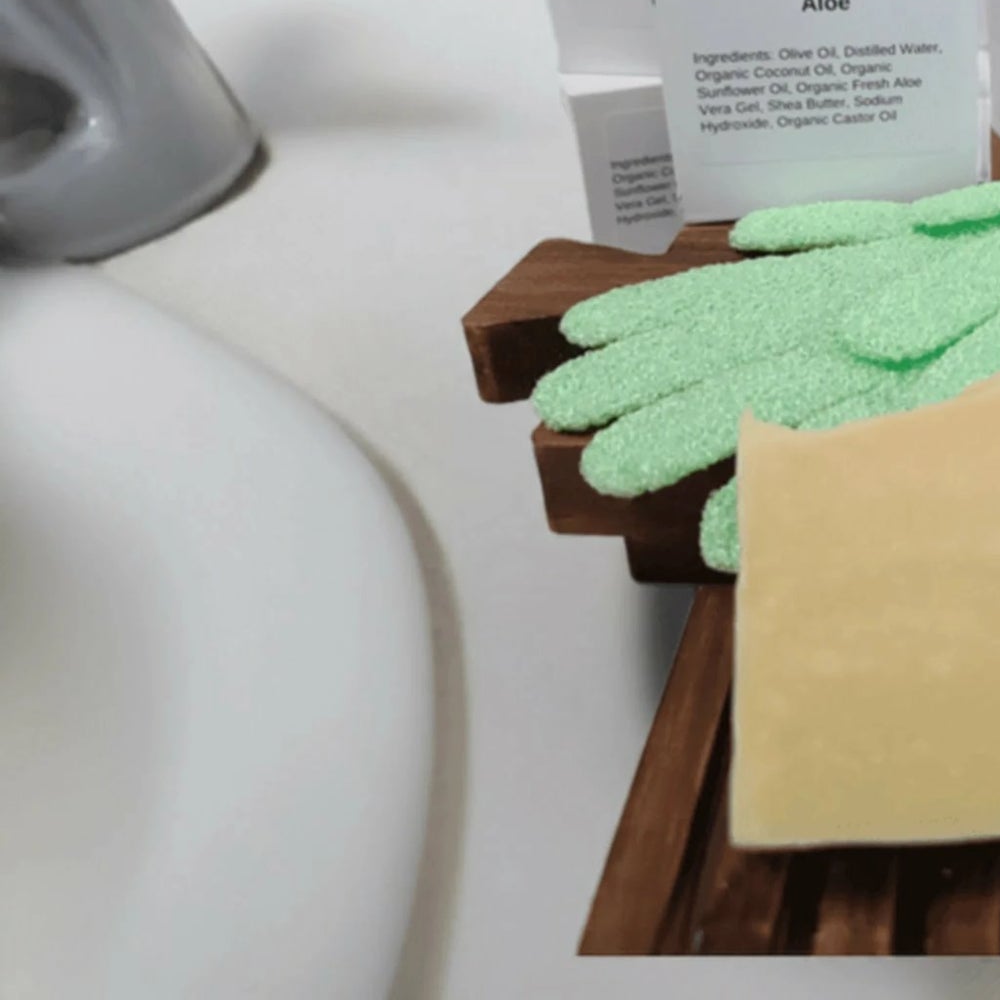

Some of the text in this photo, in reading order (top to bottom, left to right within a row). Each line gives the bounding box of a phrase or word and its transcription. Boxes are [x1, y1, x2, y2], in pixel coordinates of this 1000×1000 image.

[779, 47, 814, 62] Olive
[818, 46, 840, 60] Oil,
[844, 44, 896, 58] Distilled
[899, 42, 942, 56] Water,
[695, 62, 892, 84] Organic Coconut Oil, Organic
[697, 77, 922, 99] Sunflower Oil, Organic Fresh Aloe
[698, 94, 902, 116] Vera Gel, Shea Butter, Sodium
[700, 110, 897, 134] Hydroxide, Organic Castor Oil
